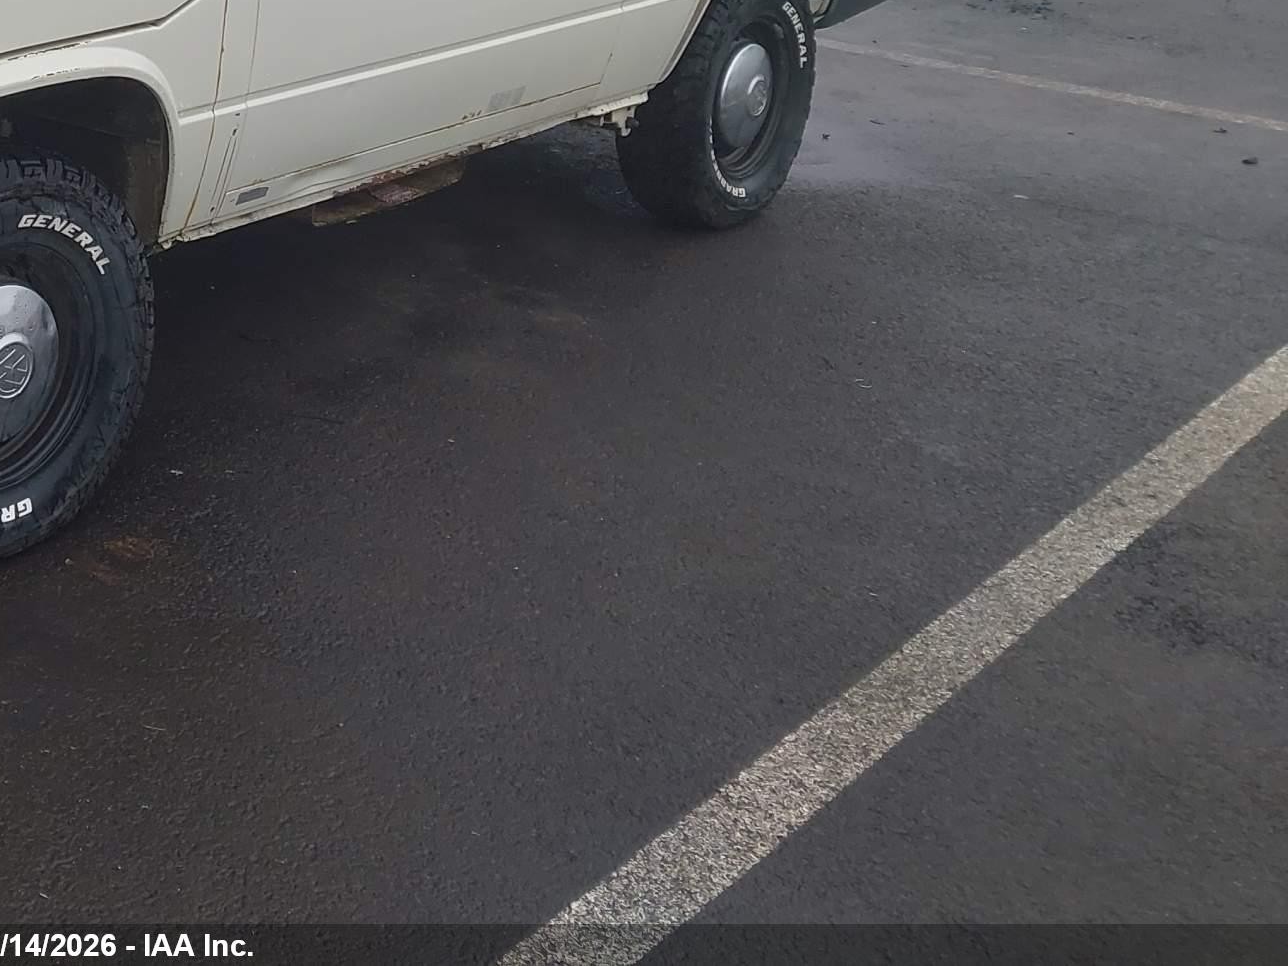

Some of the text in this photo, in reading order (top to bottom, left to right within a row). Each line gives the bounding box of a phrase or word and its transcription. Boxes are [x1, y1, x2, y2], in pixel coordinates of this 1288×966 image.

[781, 1, 808, 69] GENERAL
[710, 148, 747, 198] GRAB
[17, 213, 114, 275] GENERAL
